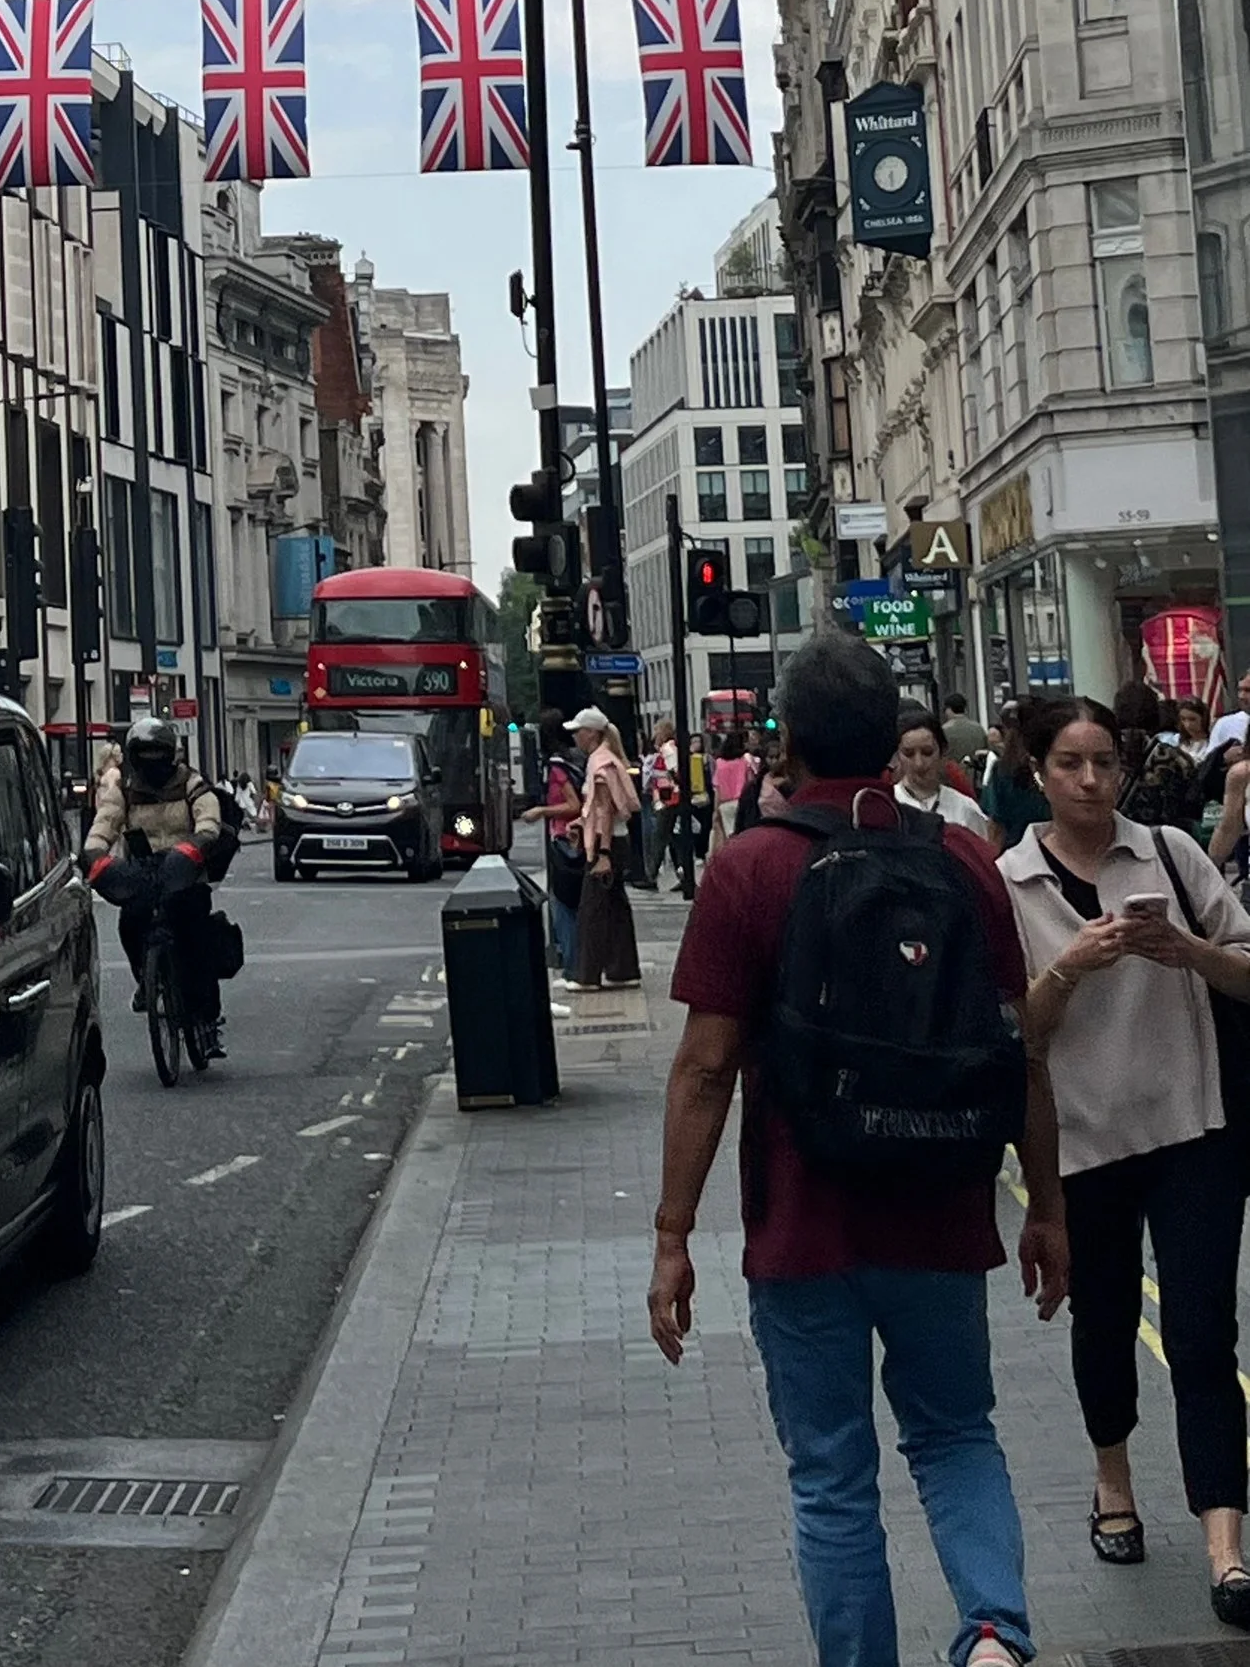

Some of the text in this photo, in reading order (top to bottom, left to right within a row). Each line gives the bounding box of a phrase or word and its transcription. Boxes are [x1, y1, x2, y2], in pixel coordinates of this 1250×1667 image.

[855, 110, 918, 132] Whittard
[863, 216, 903, 229] CHELSEA
[921, 525, 959, 564] A
[872, 599, 915, 614] FOOD
[874, 622, 917, 637] WINE
[345, 670, 450, 693] Victoria 390
